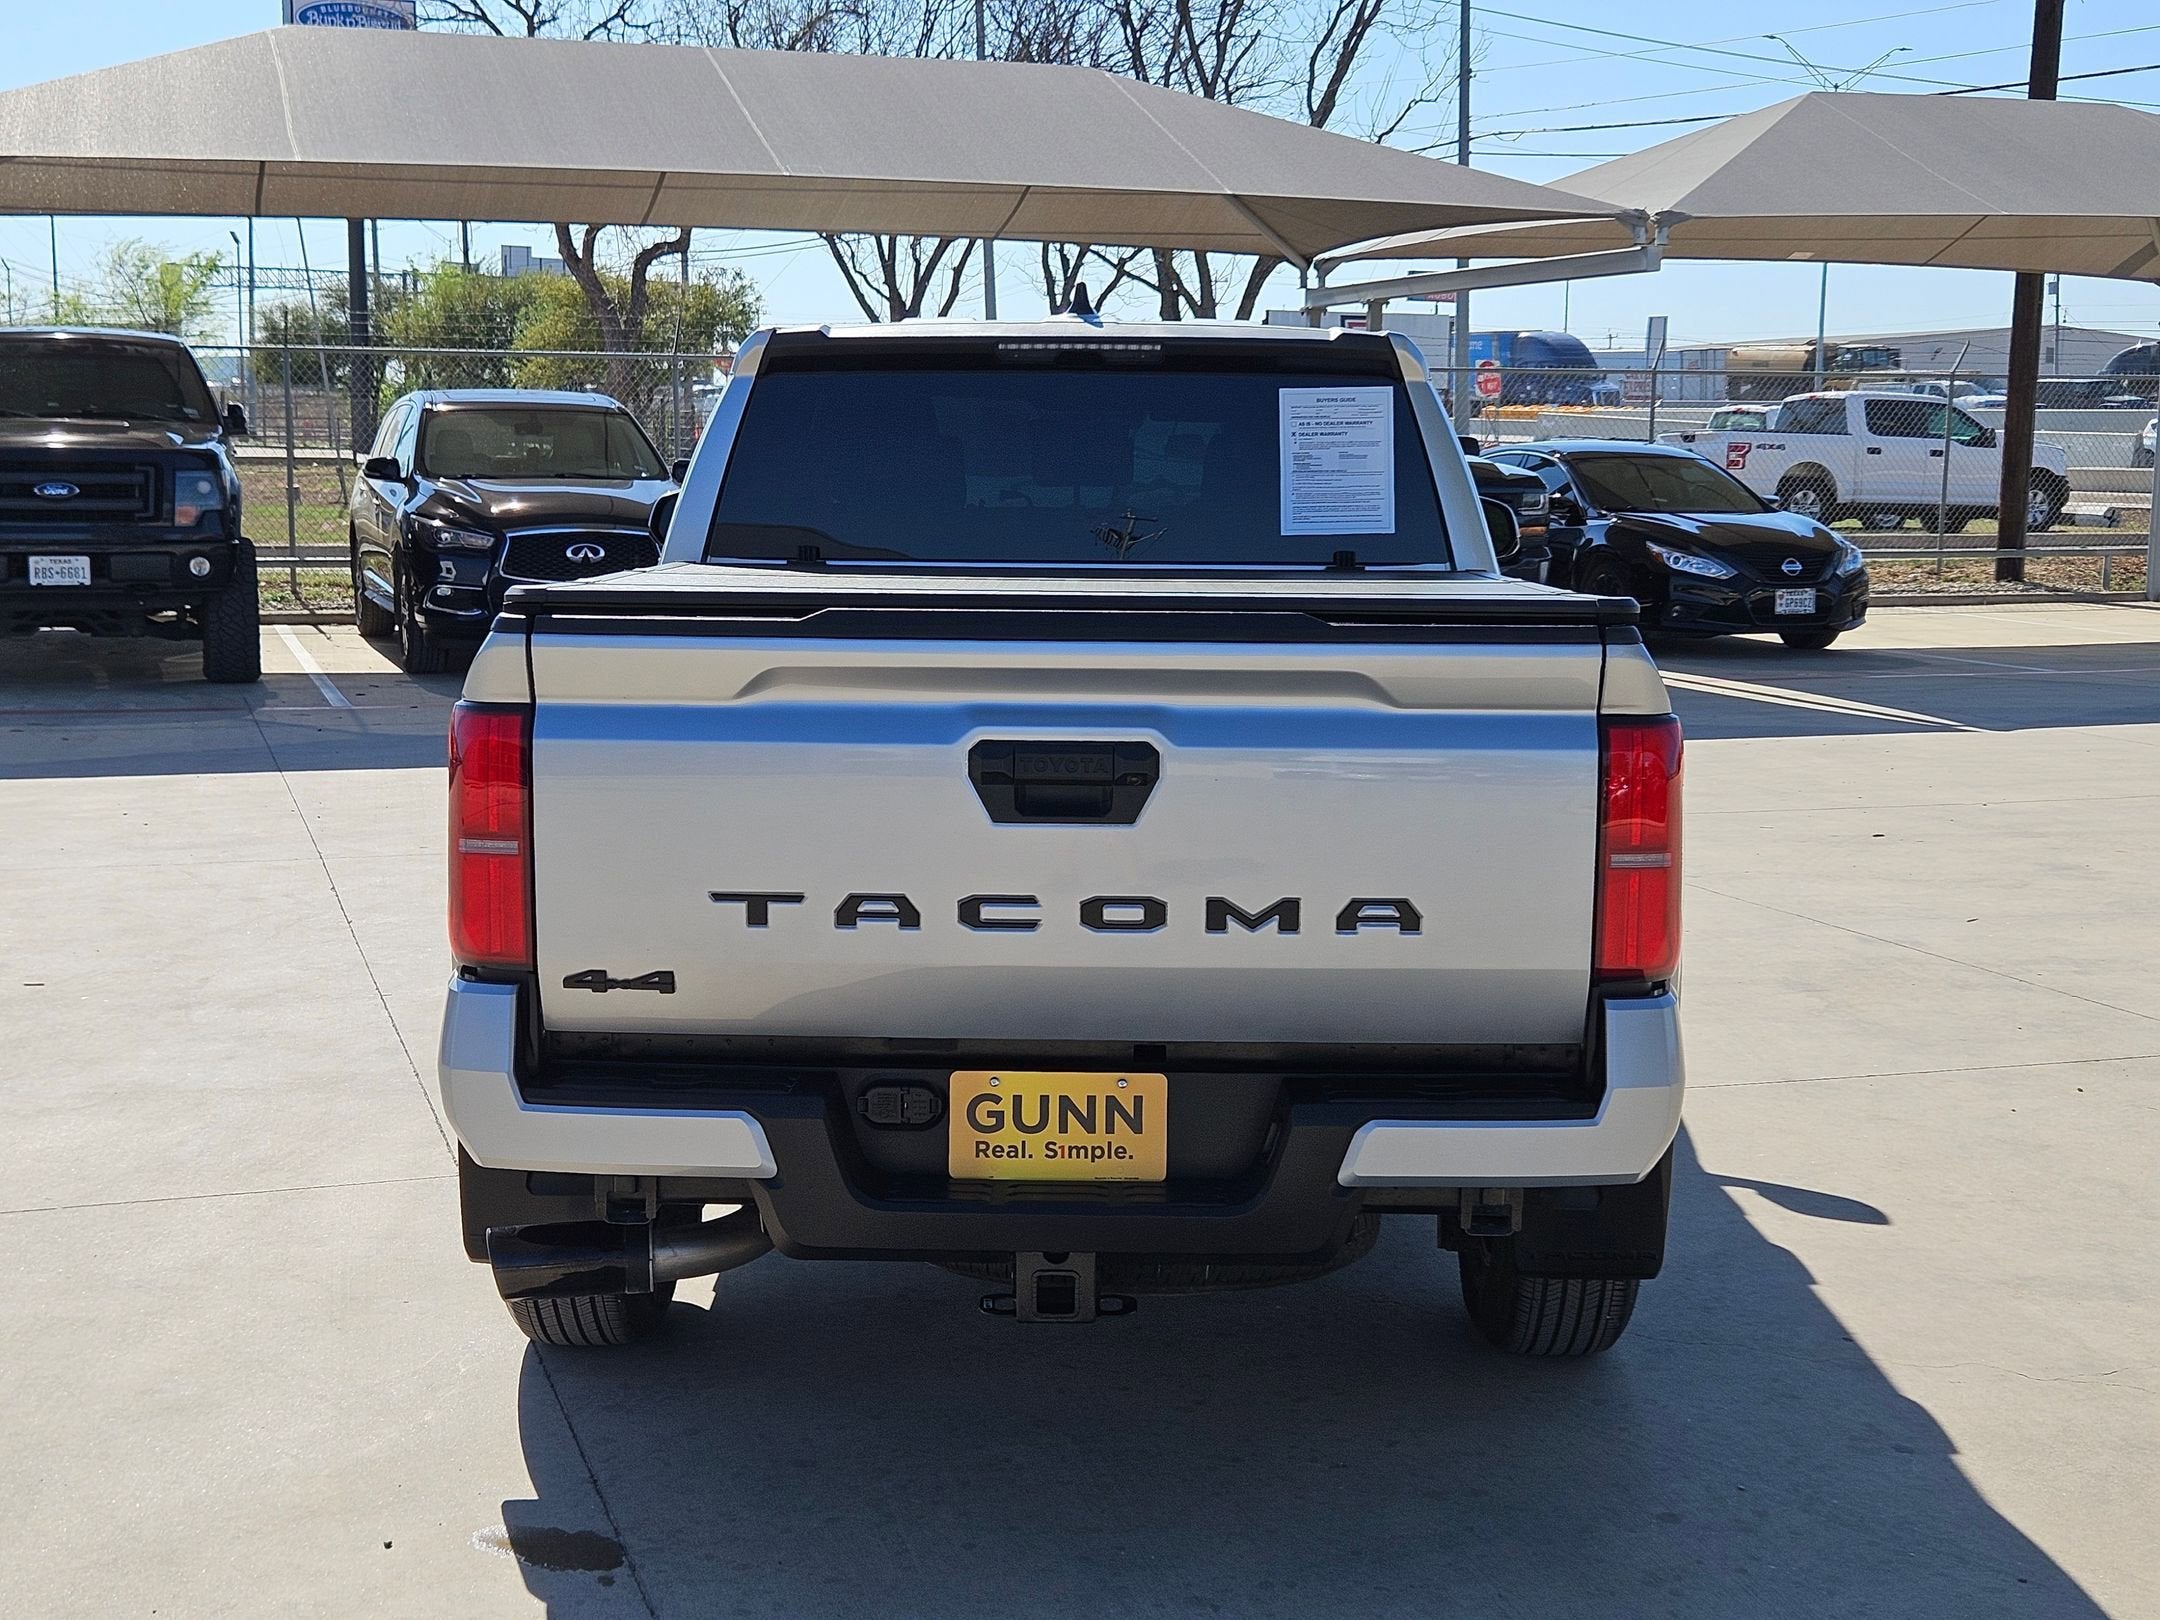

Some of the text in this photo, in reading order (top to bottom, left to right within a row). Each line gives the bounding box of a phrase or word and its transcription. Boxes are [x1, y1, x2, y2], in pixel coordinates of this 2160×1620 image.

[1019, 756, 1109, 774] TOYOTA
[708, 890, 1423, 934] TACOMA
[966, 1093, 1144, 1135] GUNN
[975, 1140, 1034, 1159] Real.
